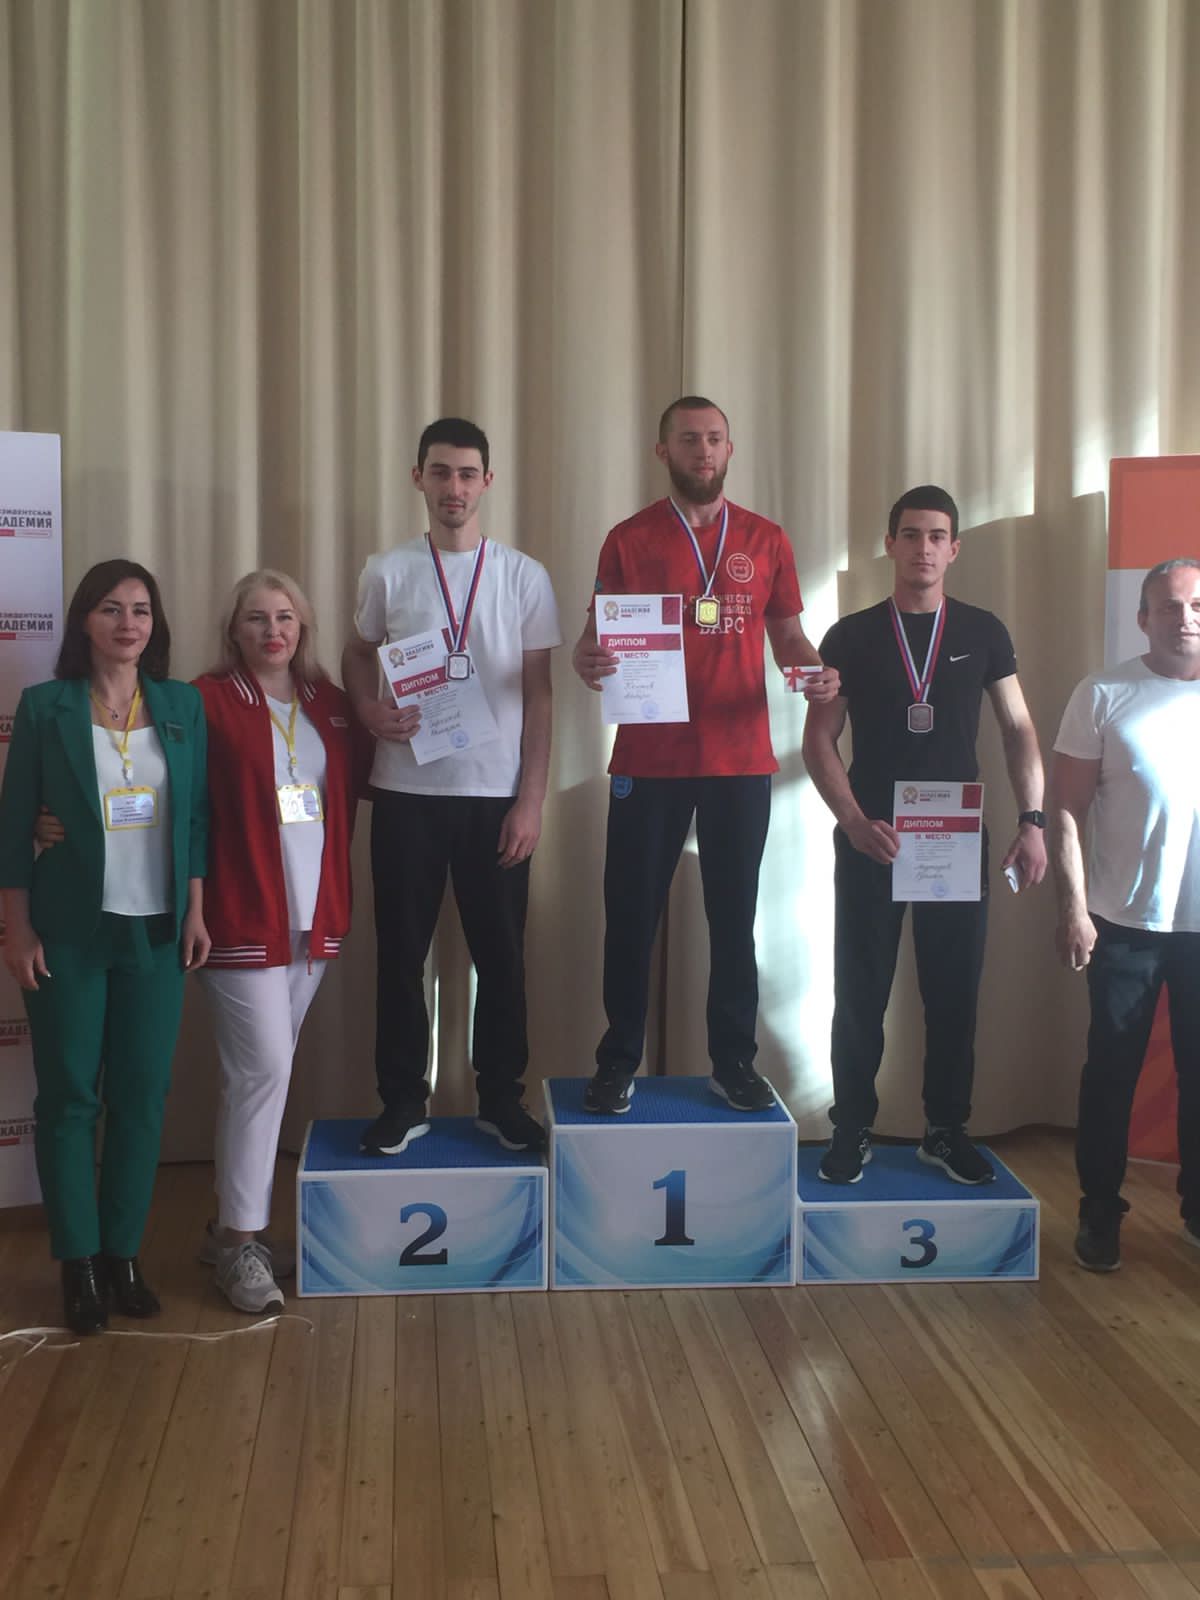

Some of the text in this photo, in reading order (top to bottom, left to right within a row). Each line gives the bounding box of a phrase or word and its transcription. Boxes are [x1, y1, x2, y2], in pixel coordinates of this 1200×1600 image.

[608, 637, 646, 647] ДИПЛОМ
[402, 673, 439, 692] ДИПЛОМ
[904, 819, 944, 829] ДИПЛОМ
[653, 1170, 695, 1246] 1
[400, 1203, 448, 1266] 2
[900, 1218, 938, 1269] 3
